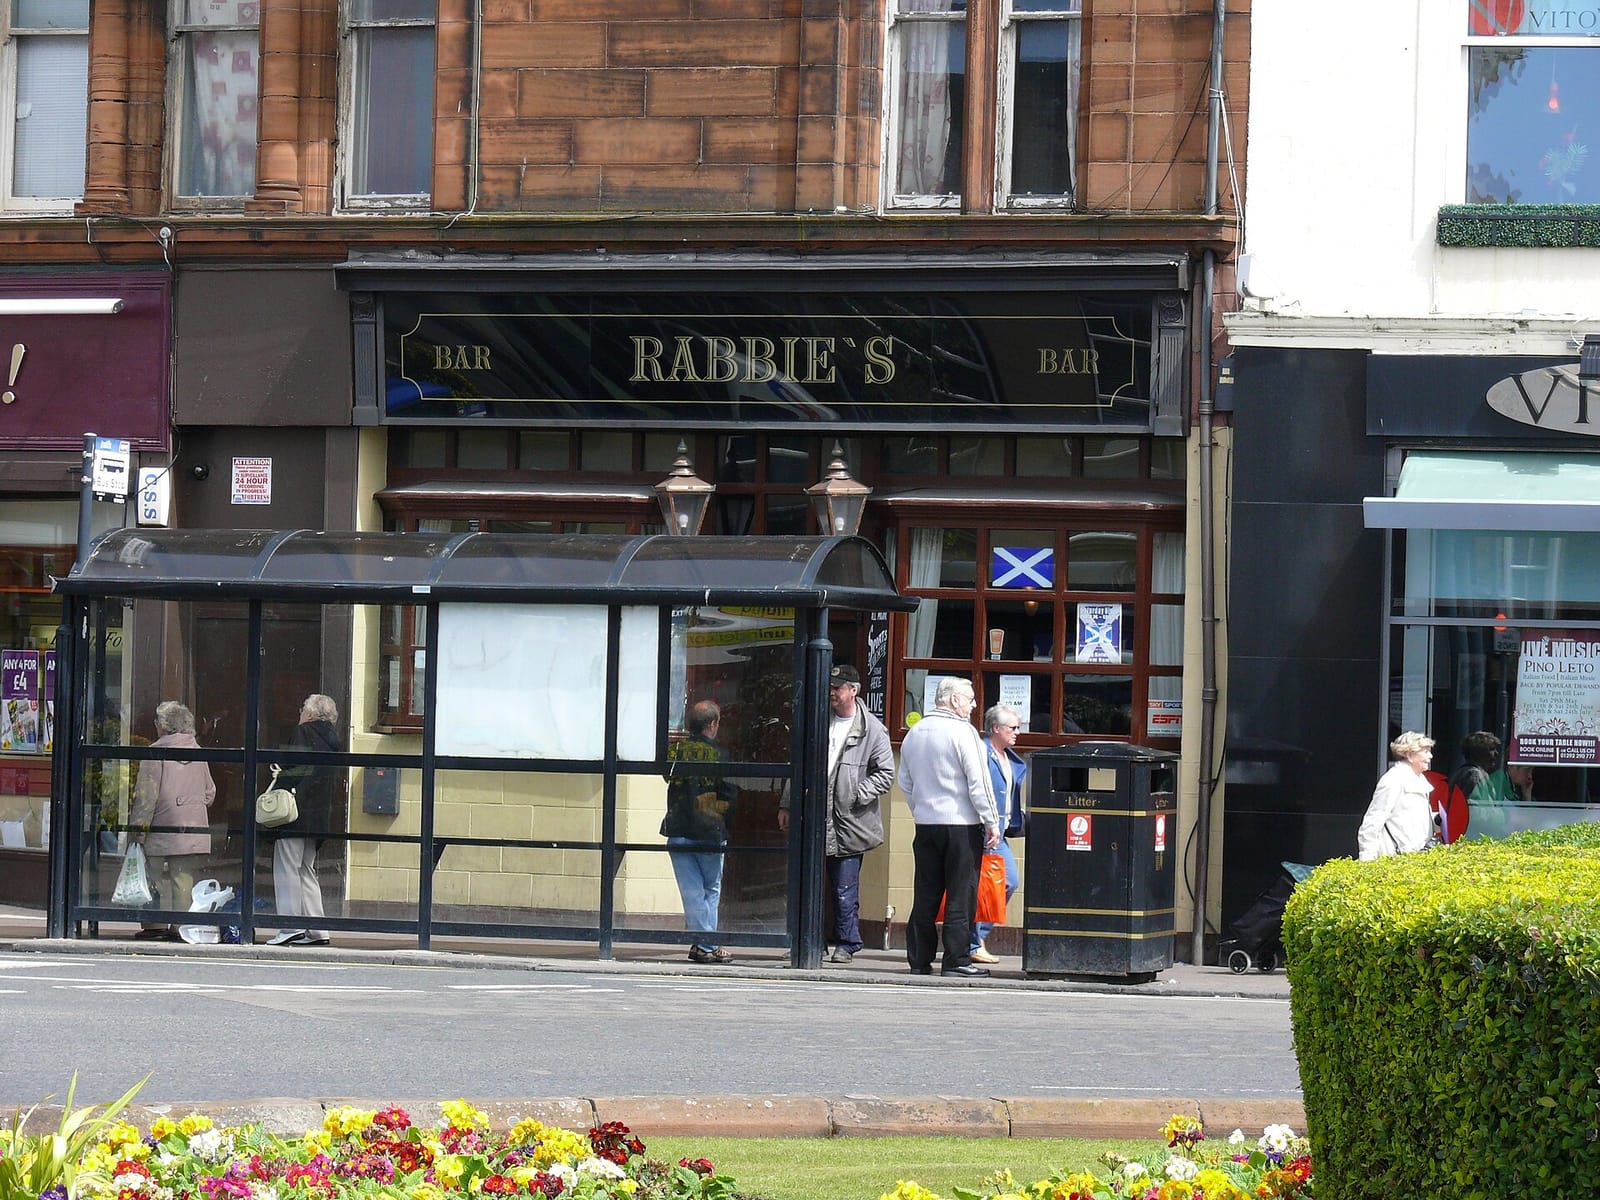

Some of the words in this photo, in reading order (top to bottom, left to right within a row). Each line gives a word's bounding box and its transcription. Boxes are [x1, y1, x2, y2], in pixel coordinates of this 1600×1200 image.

[1530, 8, 1600, 29] VITO
[432, 344, 492, 370] BAR
[1037, 348, 1100, 374] BAR
[1521, 641, 1549, 657] LIVE
[1551, 641, 1600, 658] MUSIC
[3, 659, 18, 670] ANY
[18, 660, 23, 670] 4
[24, 659, 37, 670] FOR
[46, 660, 56, 670] AN
[1525, 660, 1555, 673] PINO
[1559, 661, 1595, 673] LETO
[13, 671, 27, 690] £4
[866, 692, 884, 712] LIVE
[1067, 796, 1097, 806] Litter
